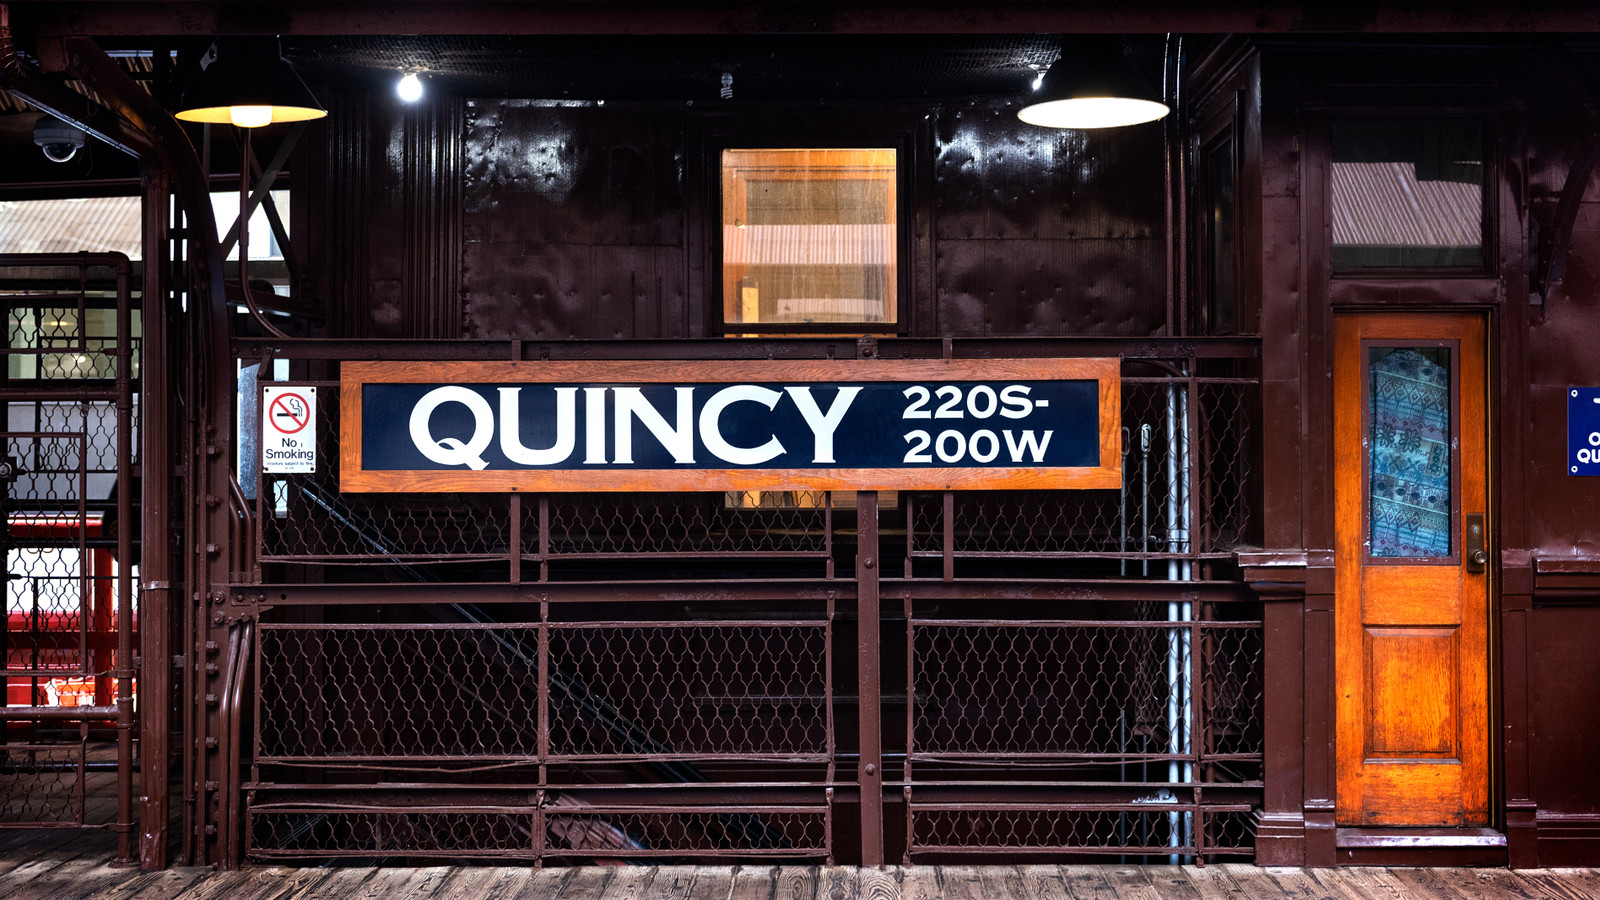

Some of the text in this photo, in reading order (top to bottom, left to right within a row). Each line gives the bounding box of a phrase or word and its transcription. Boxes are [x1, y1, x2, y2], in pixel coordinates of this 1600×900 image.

[902, 384, 1049, 420] 220S-
[281, 438, 297, 448] No
[408, 385, 863, 471] QUINCY
[265, 448, 313, 461] Smoking
[902, 429, 1054, 464] 200W
